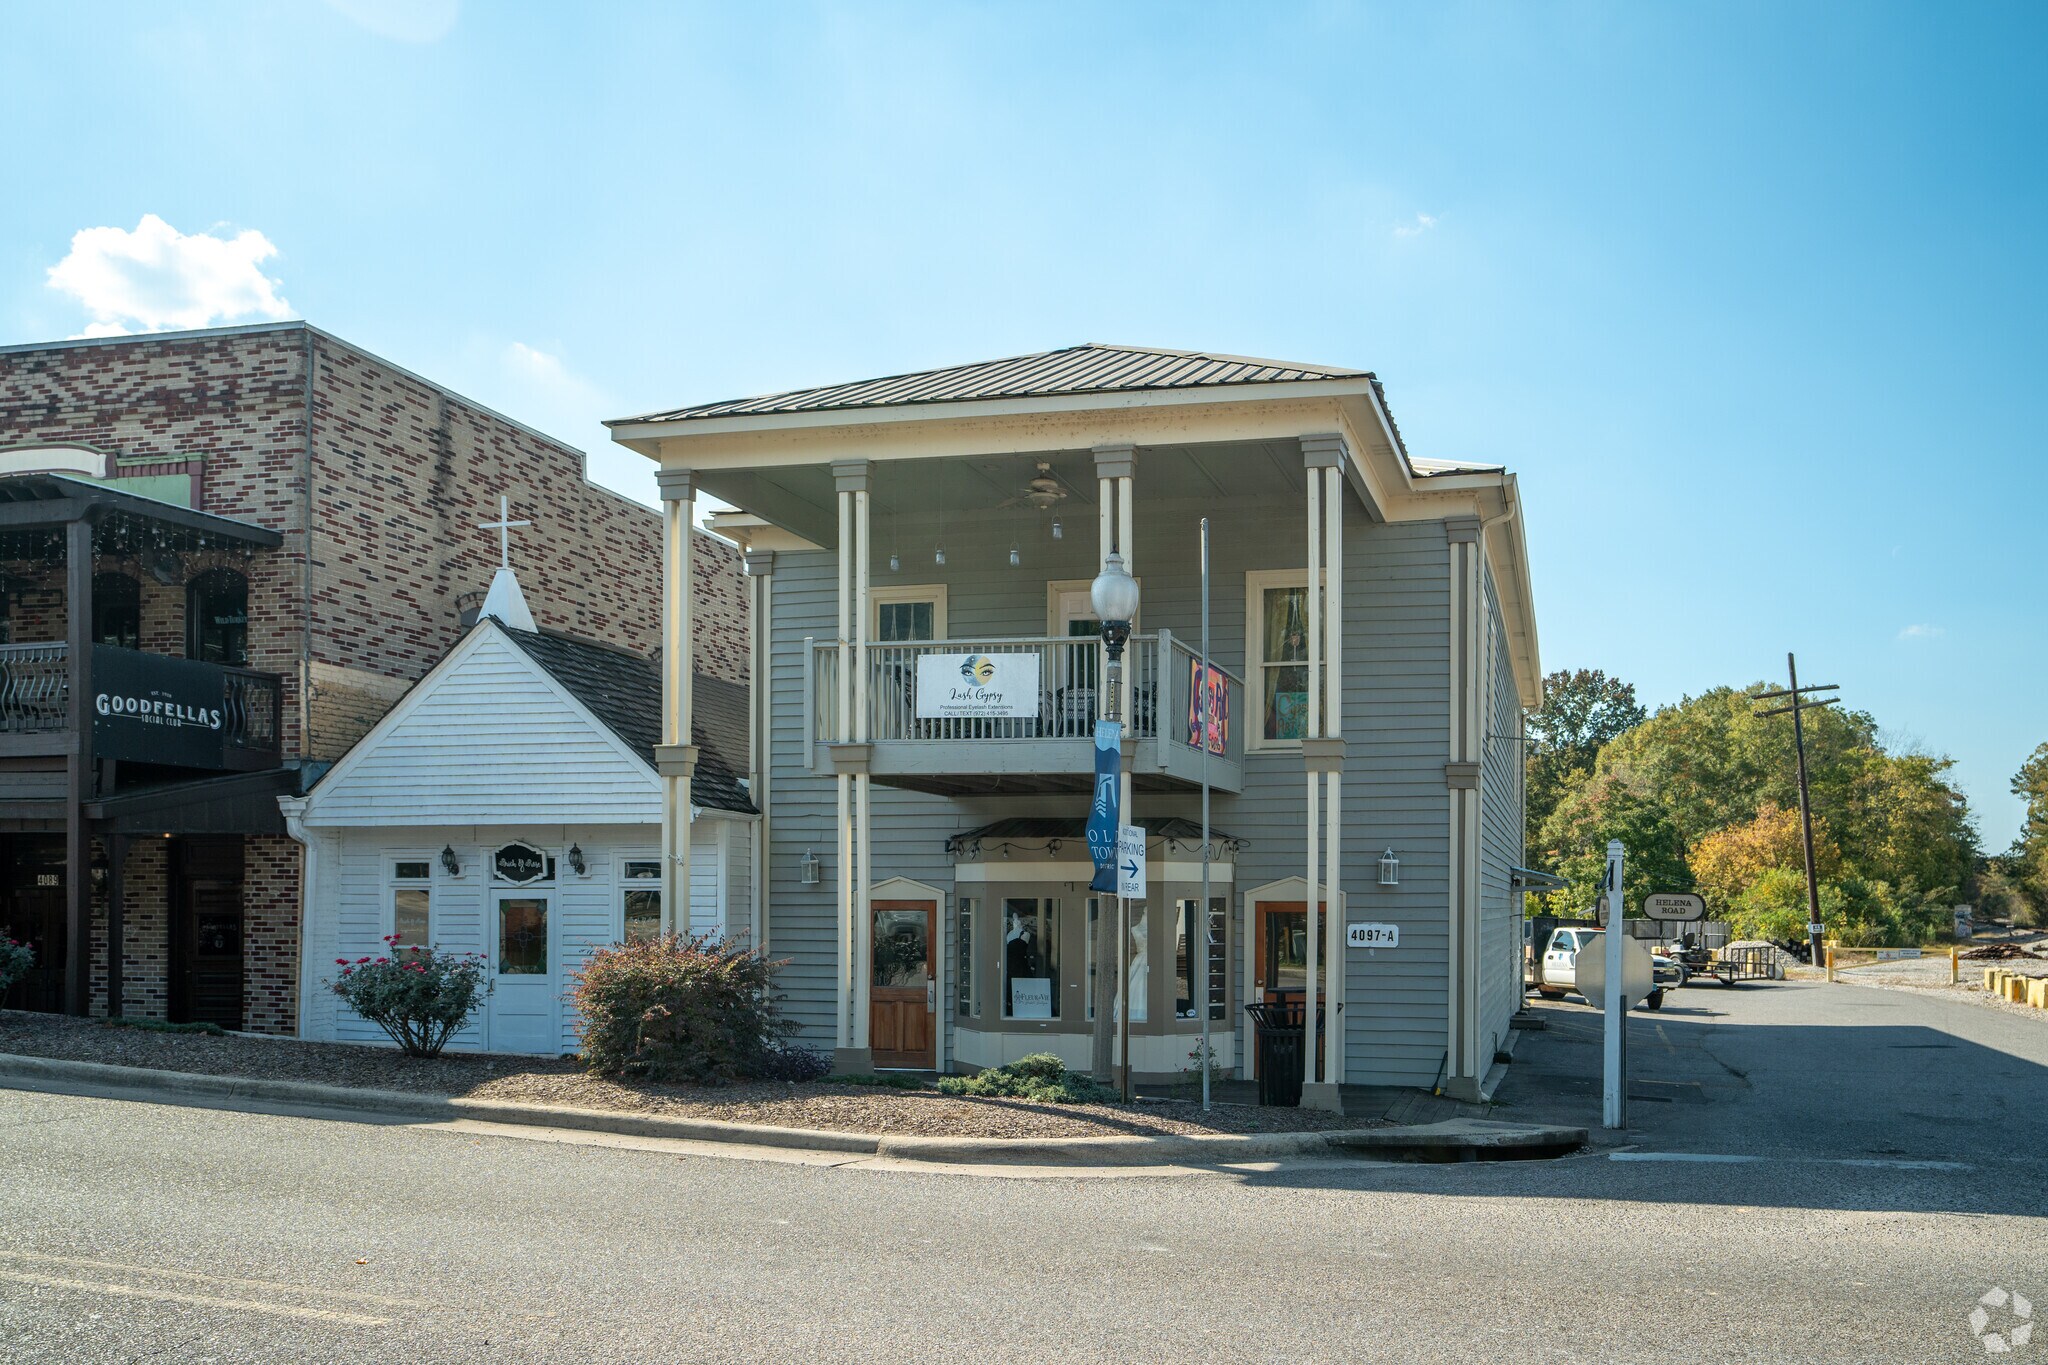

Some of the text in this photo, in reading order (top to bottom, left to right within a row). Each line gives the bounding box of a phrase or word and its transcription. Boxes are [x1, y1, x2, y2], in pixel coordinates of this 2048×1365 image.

[949, 687, 1003, 703] Lash Gypsy
[96, 693, 221, 729] GOODFELLAS
[141, 714, 182, 727] SOCIAL CLUB
[1119, 841, 1144, 857] PARKING
[38, 875, 59, 886] 4089
[1125, 883, 1140, 892] REAR
[1655, 899, 1692, 907] HELENA
[1661, 907, 1686, 915] ROAD
[1351, 929, 1394, 942] 4097-A
